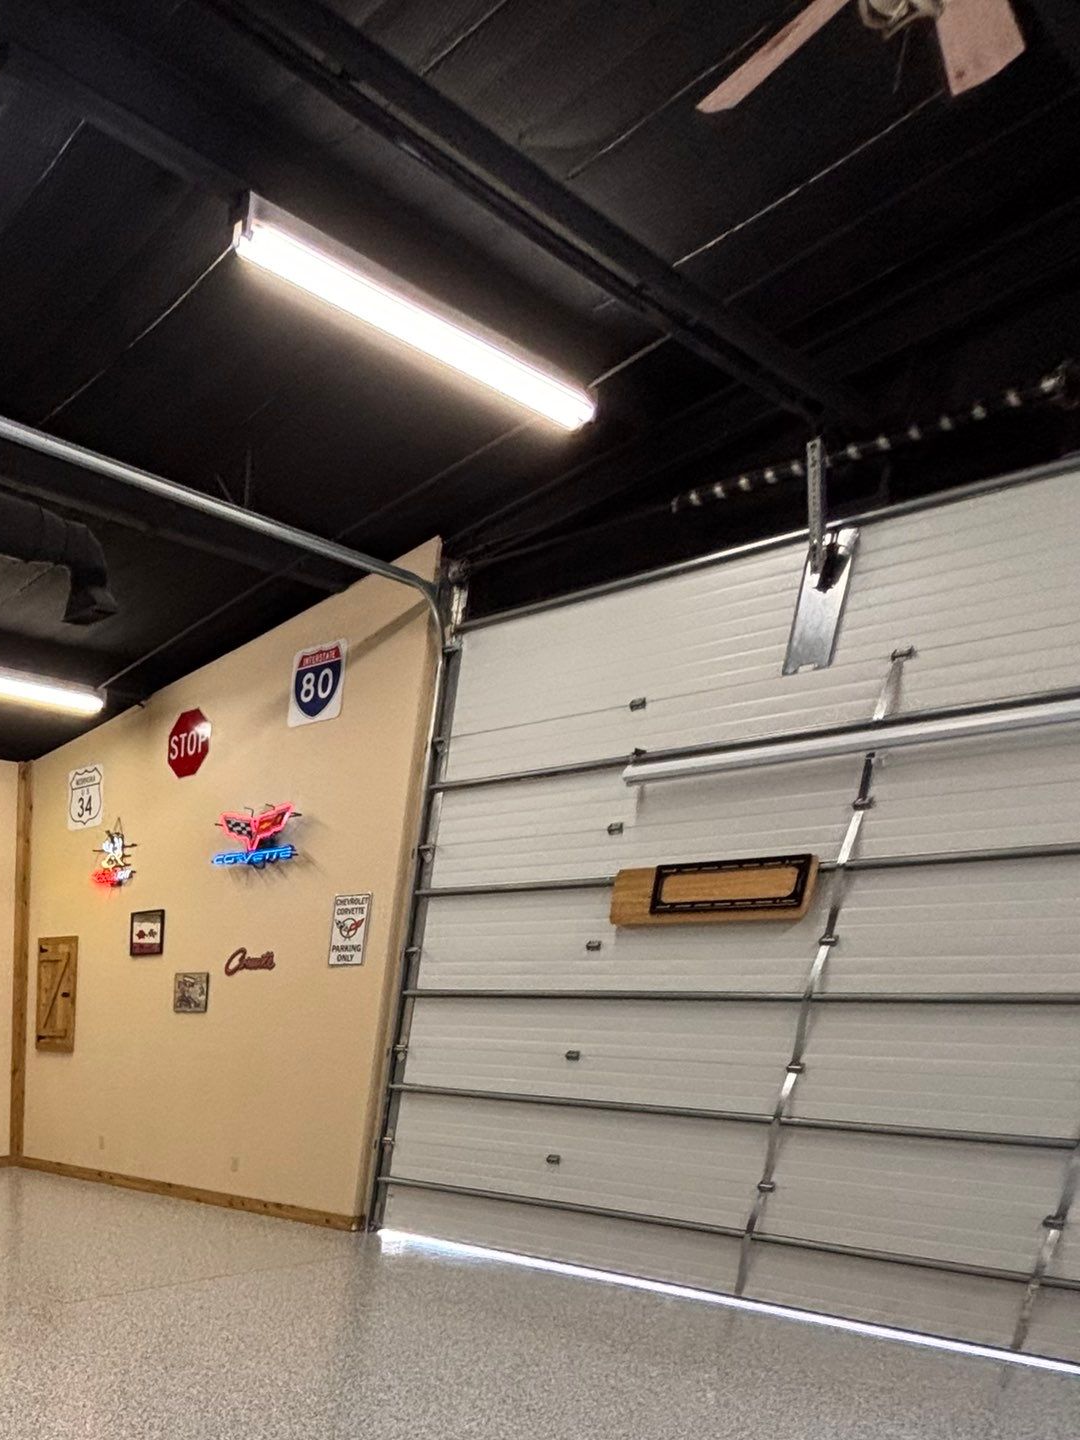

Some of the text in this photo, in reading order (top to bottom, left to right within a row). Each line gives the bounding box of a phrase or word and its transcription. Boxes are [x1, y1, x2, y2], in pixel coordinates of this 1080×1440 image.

[302, 650, 336, 666] INTERSTATE
[300, 668, 333, 703] 80
[170, 729, 207, 760] STOP
[77, 795, 93, 818] 34
[213, 846, 293, 865] CORVETTE
[335, 897, 369, 906] CHEVROLET
[336, 907, 365, 916] CORVETTE
[332, 944, 361, 953] PARKING
[336, 953, 354, 962] ONLY
